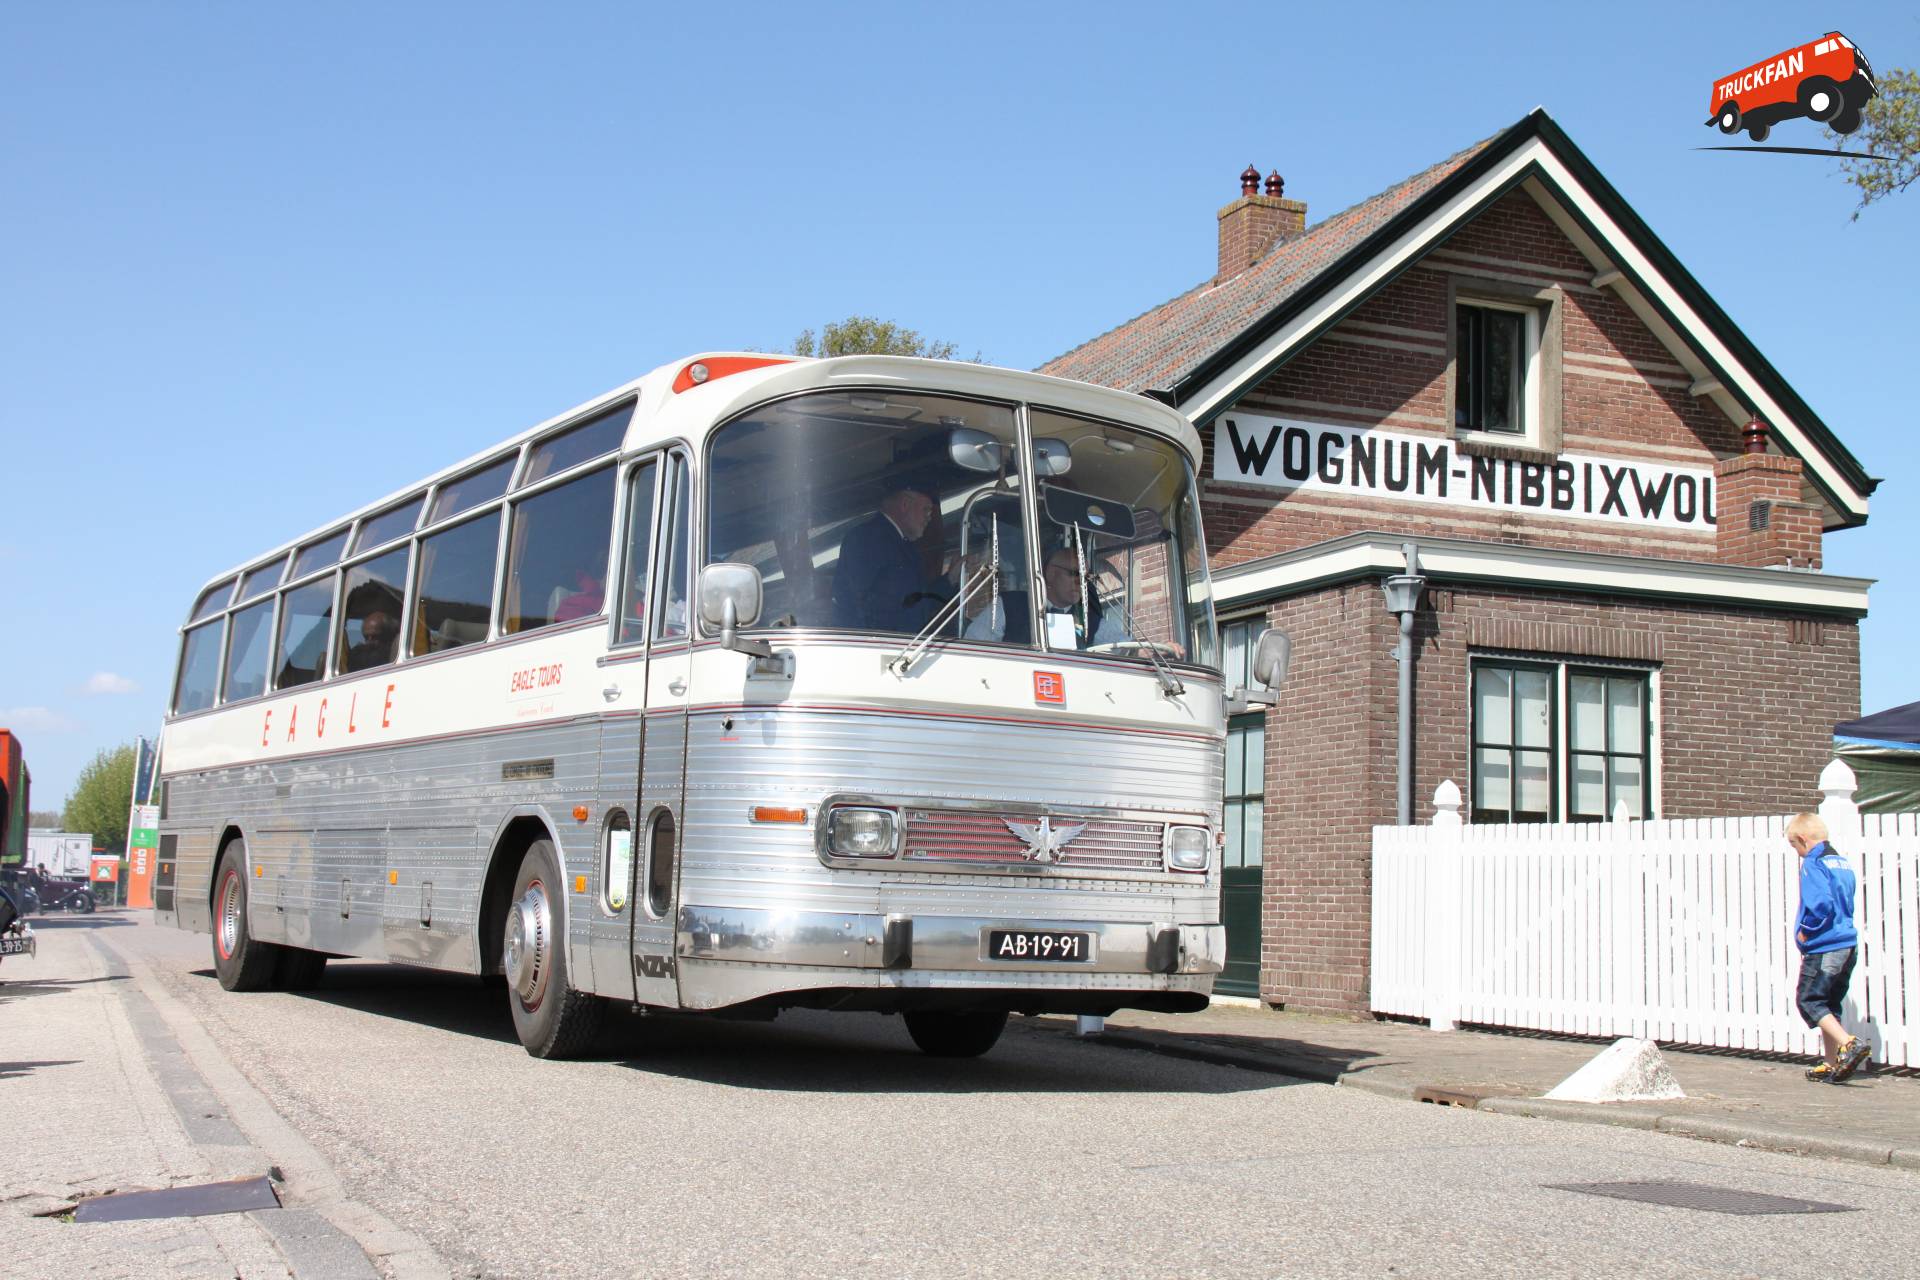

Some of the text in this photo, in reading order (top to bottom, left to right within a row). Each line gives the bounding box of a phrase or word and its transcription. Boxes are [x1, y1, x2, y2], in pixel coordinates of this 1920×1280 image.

[510, 663, 563, 693] EAGLE TOURS
[262, 684, 395, 747] EAGLE
[999, 934, 1079, 957] AB-19-91
[634, 954, 675, 979] NZH
